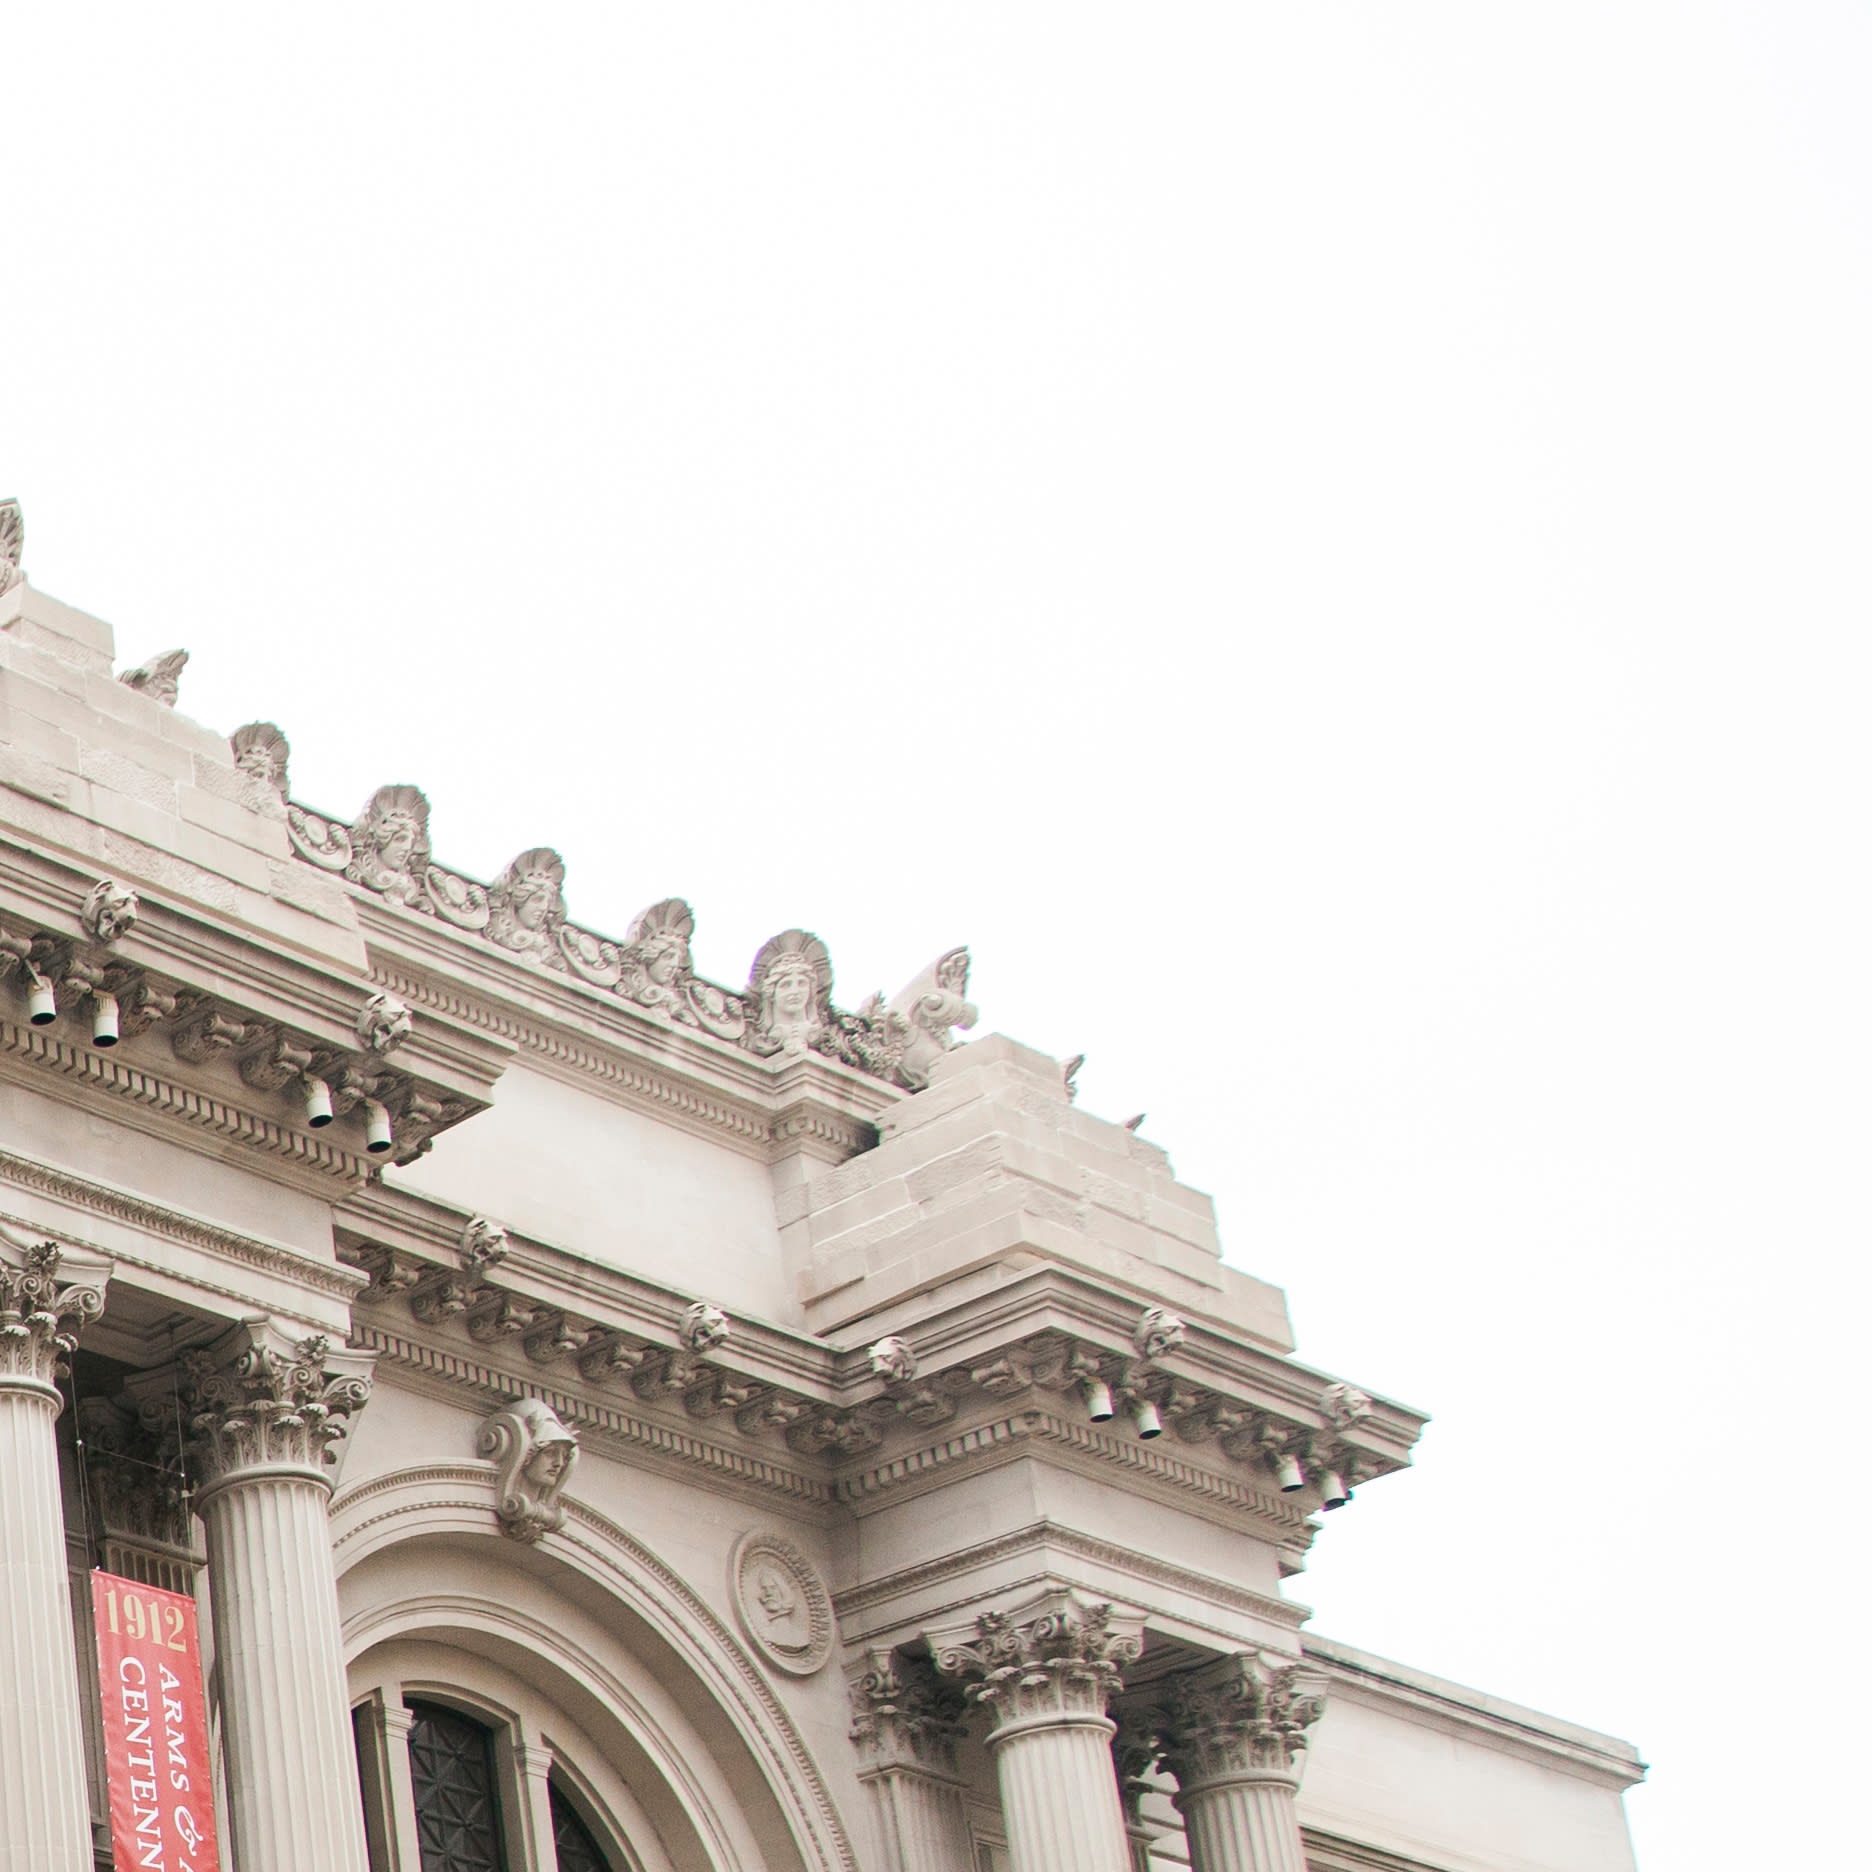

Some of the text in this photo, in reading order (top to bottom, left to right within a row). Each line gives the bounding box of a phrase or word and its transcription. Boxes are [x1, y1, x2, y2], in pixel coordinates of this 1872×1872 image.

[104, 1589, 187, 1653] 1912
[158, 1662, 191, 1792] ARMS
[173, 1805, 204, 1857] &
